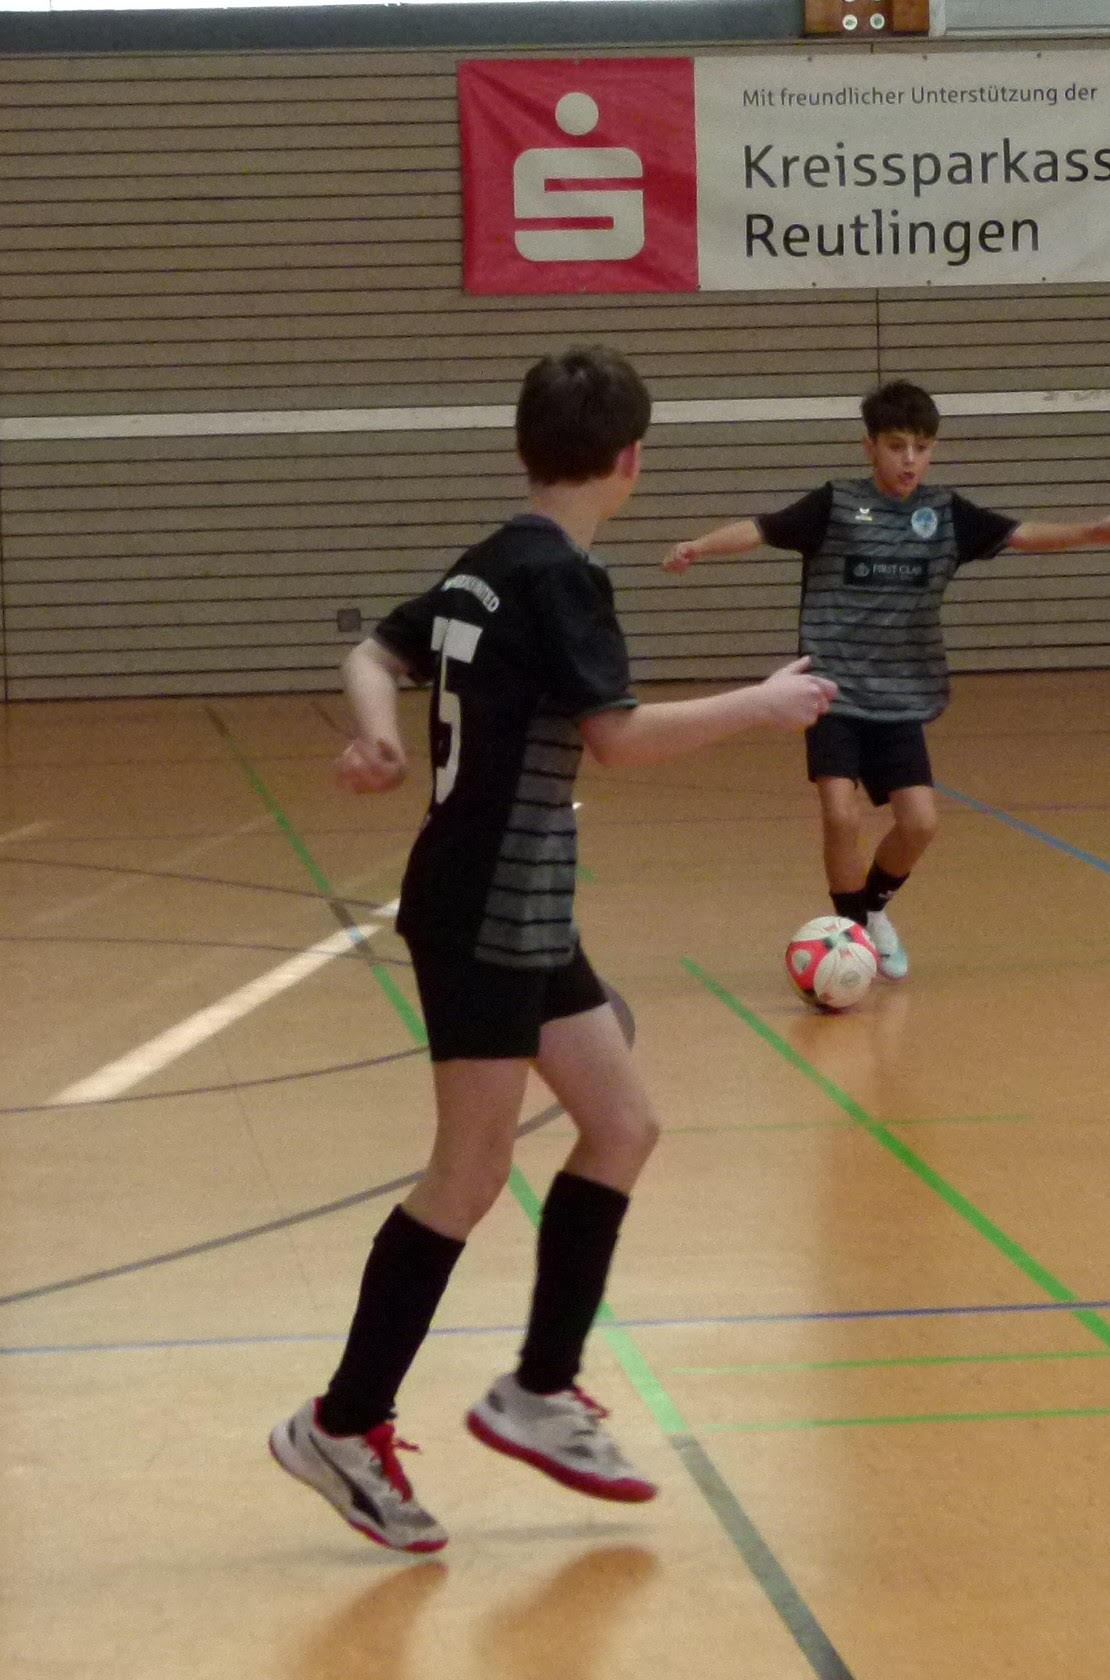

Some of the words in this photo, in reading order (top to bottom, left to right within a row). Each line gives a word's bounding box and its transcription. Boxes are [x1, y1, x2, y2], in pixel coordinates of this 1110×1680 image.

[743, 89, 775, 106] Mit
[780, 87, 905, 105] freundlicher
[911, 84, 1058, 105] Unterstützung
[1064, 83, 1098, 101] der
[745, 209, 1040, 266] Reutlingen
